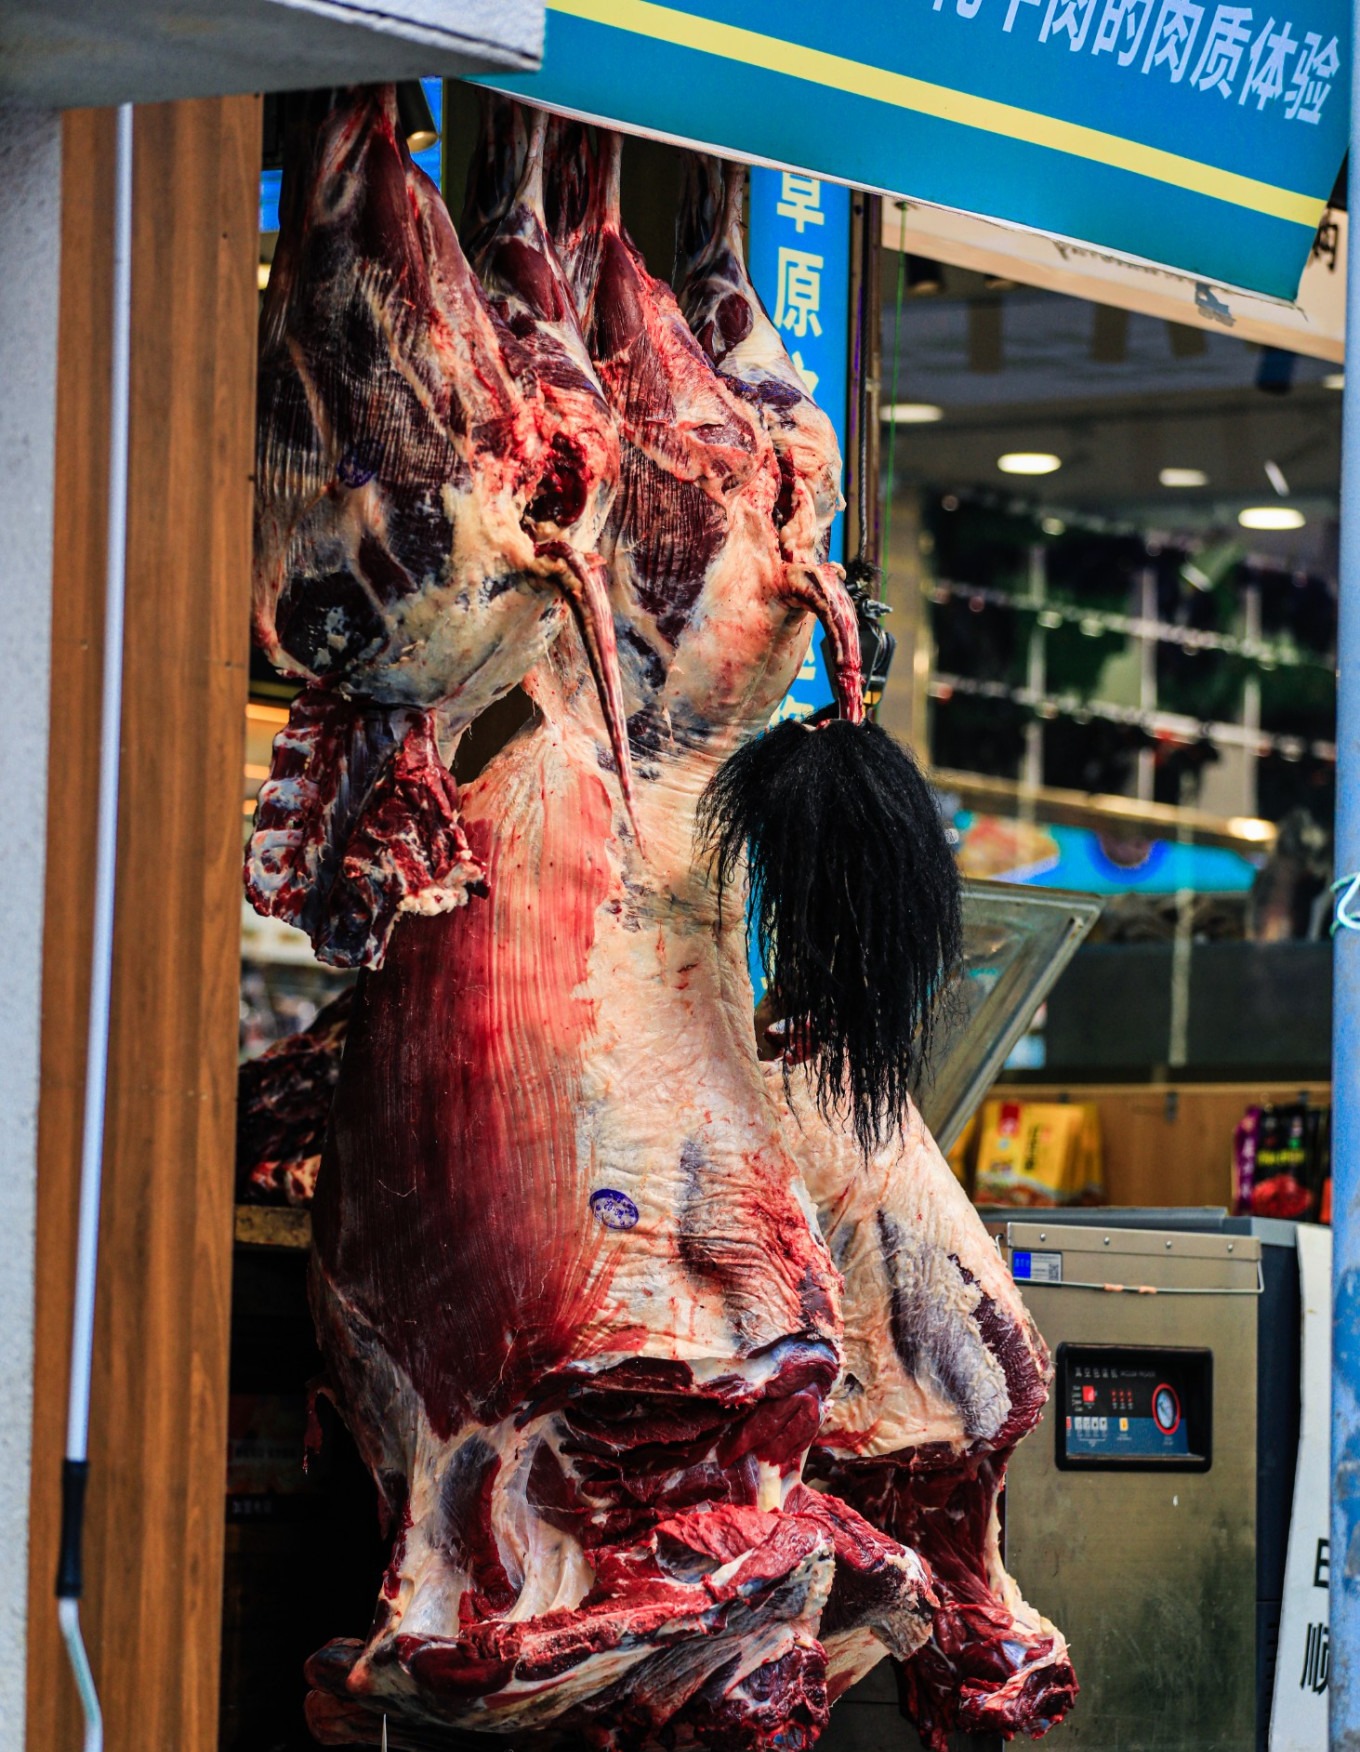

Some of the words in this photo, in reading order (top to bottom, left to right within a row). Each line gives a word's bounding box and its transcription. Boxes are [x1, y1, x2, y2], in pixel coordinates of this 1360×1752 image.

[932, 0, 1341, 125] 肉的肉质体验
